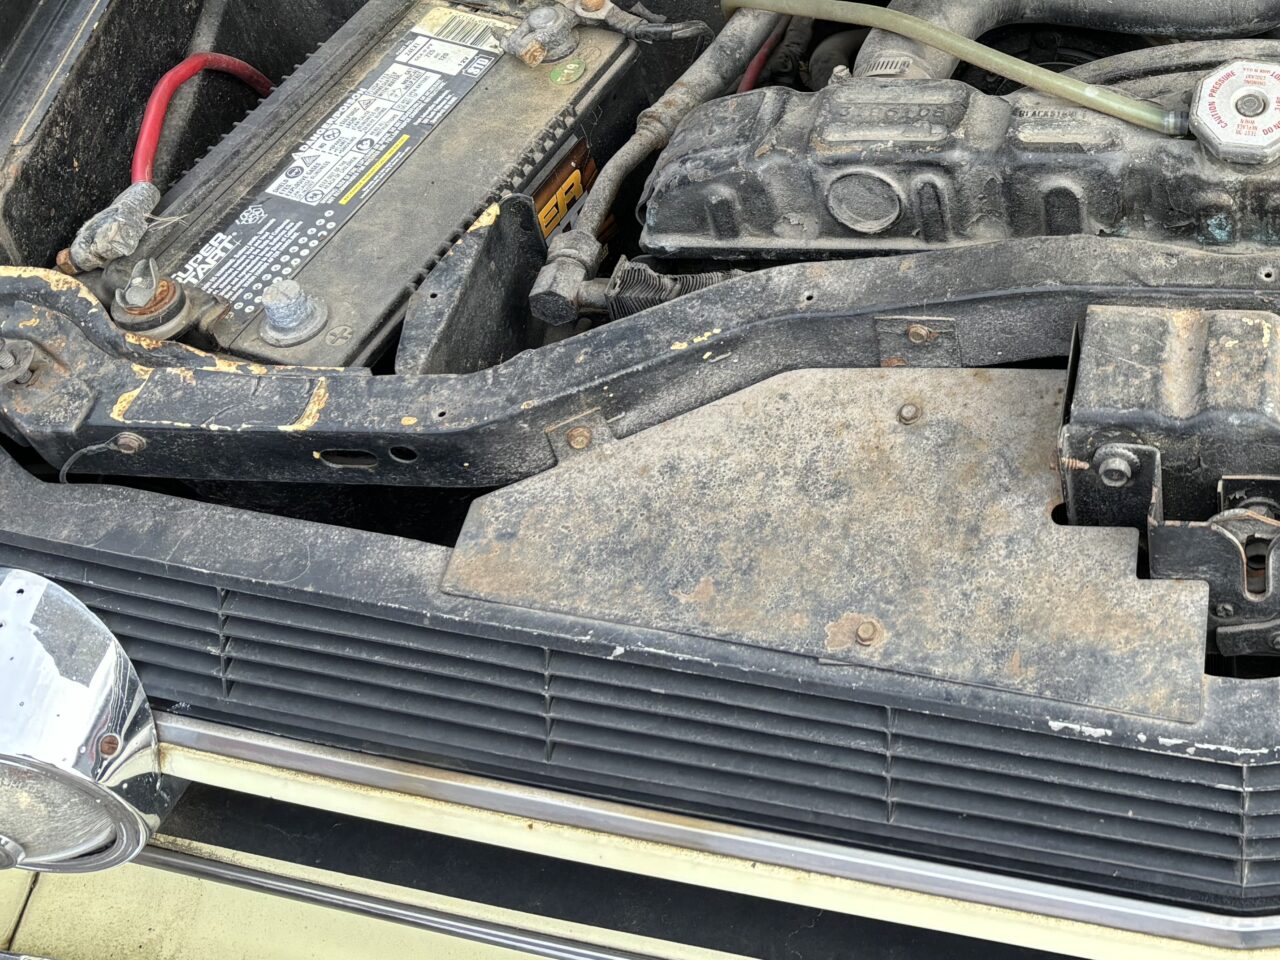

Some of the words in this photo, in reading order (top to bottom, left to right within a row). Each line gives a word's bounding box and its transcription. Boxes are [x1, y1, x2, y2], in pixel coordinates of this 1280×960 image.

[456, 56, 470, 66] 12V
[465, 57, 491, 75] STD
[1208, 70, 1236, 97] PRESSURE
[1208, 101, 1228, 129] CAUTION
[1262, 127, 1274, 136] DO
[184, 236, 233, 285] TART
